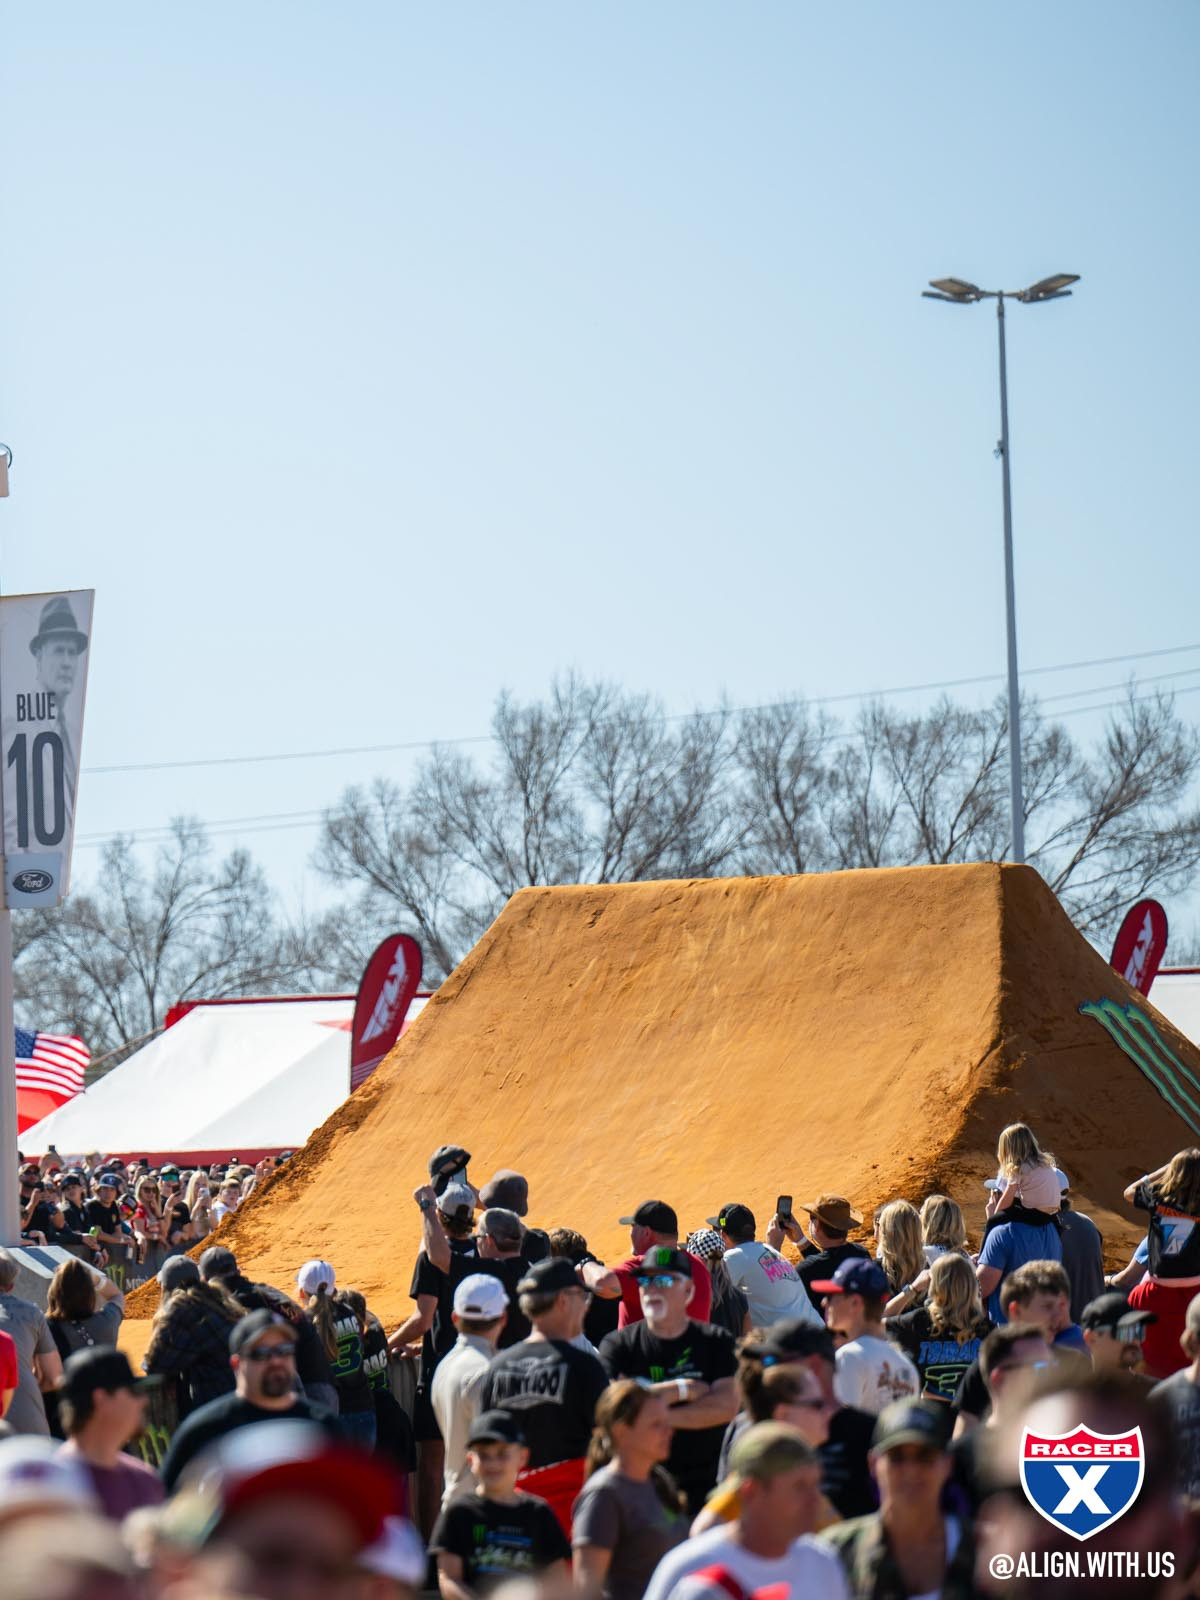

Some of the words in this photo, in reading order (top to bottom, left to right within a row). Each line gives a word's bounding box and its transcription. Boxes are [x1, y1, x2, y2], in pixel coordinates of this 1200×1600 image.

[16, 692, 56, 722] BLUE
[7, 731, 66, 848] 10
[333, 1316, 360, 1337] MAC
